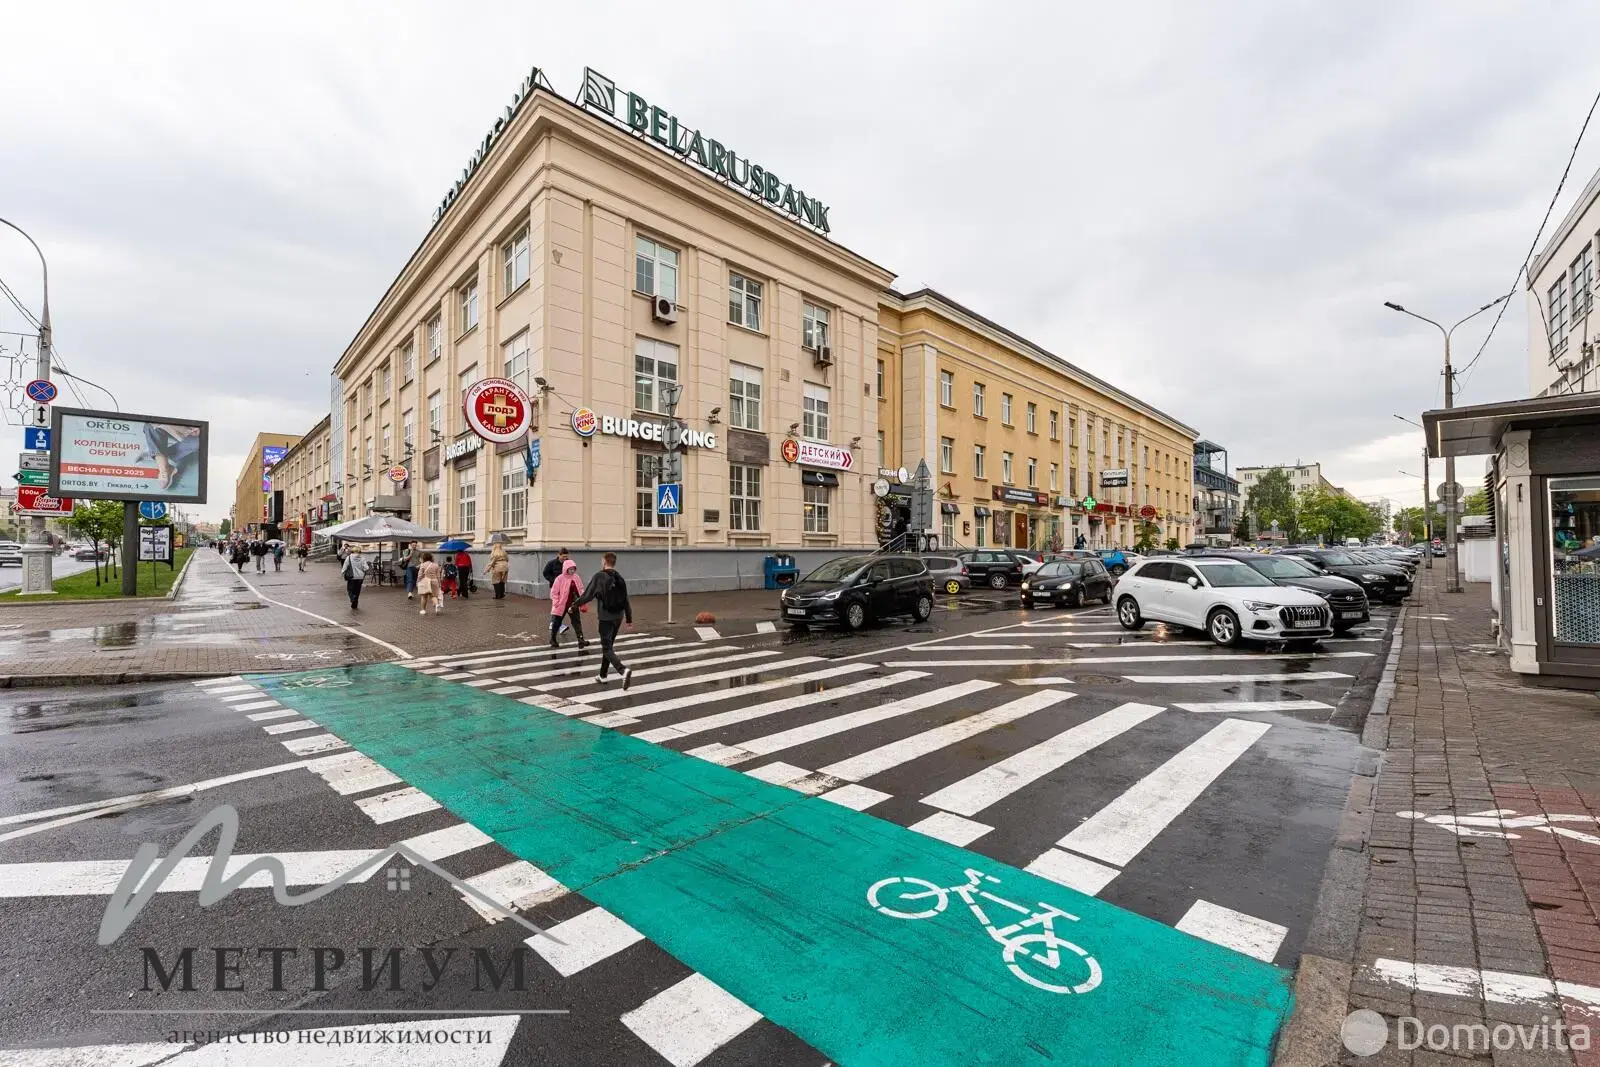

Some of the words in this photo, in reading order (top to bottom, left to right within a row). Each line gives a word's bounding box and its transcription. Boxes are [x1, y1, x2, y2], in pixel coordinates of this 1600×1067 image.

[627, 90, 831, 233] BELARUSBANK
[487, 405, 514, 415] ЛОДЭ
[576, 413, 593, 422] BURGER
[576, 417, 595, 430] KING
[86, 420, 130, 431] ORTOS
[482, 419, 519, 434] КАЧЕСТВА
[602, 415, 665, 442] BURGE
[679, 428, 716, 449] KING
[74, 439, 141, 451] КОЛЛЕКЦИЯ
[446, 438, 467, 461] BURGER
[466, 432, 482, 452] KING
[89, 449, 126, 457] ОБУВИ
[801, 445, 841, 461] ДЕТСКИЙ
[61, 479, 98, 487] ORTOS.BY
